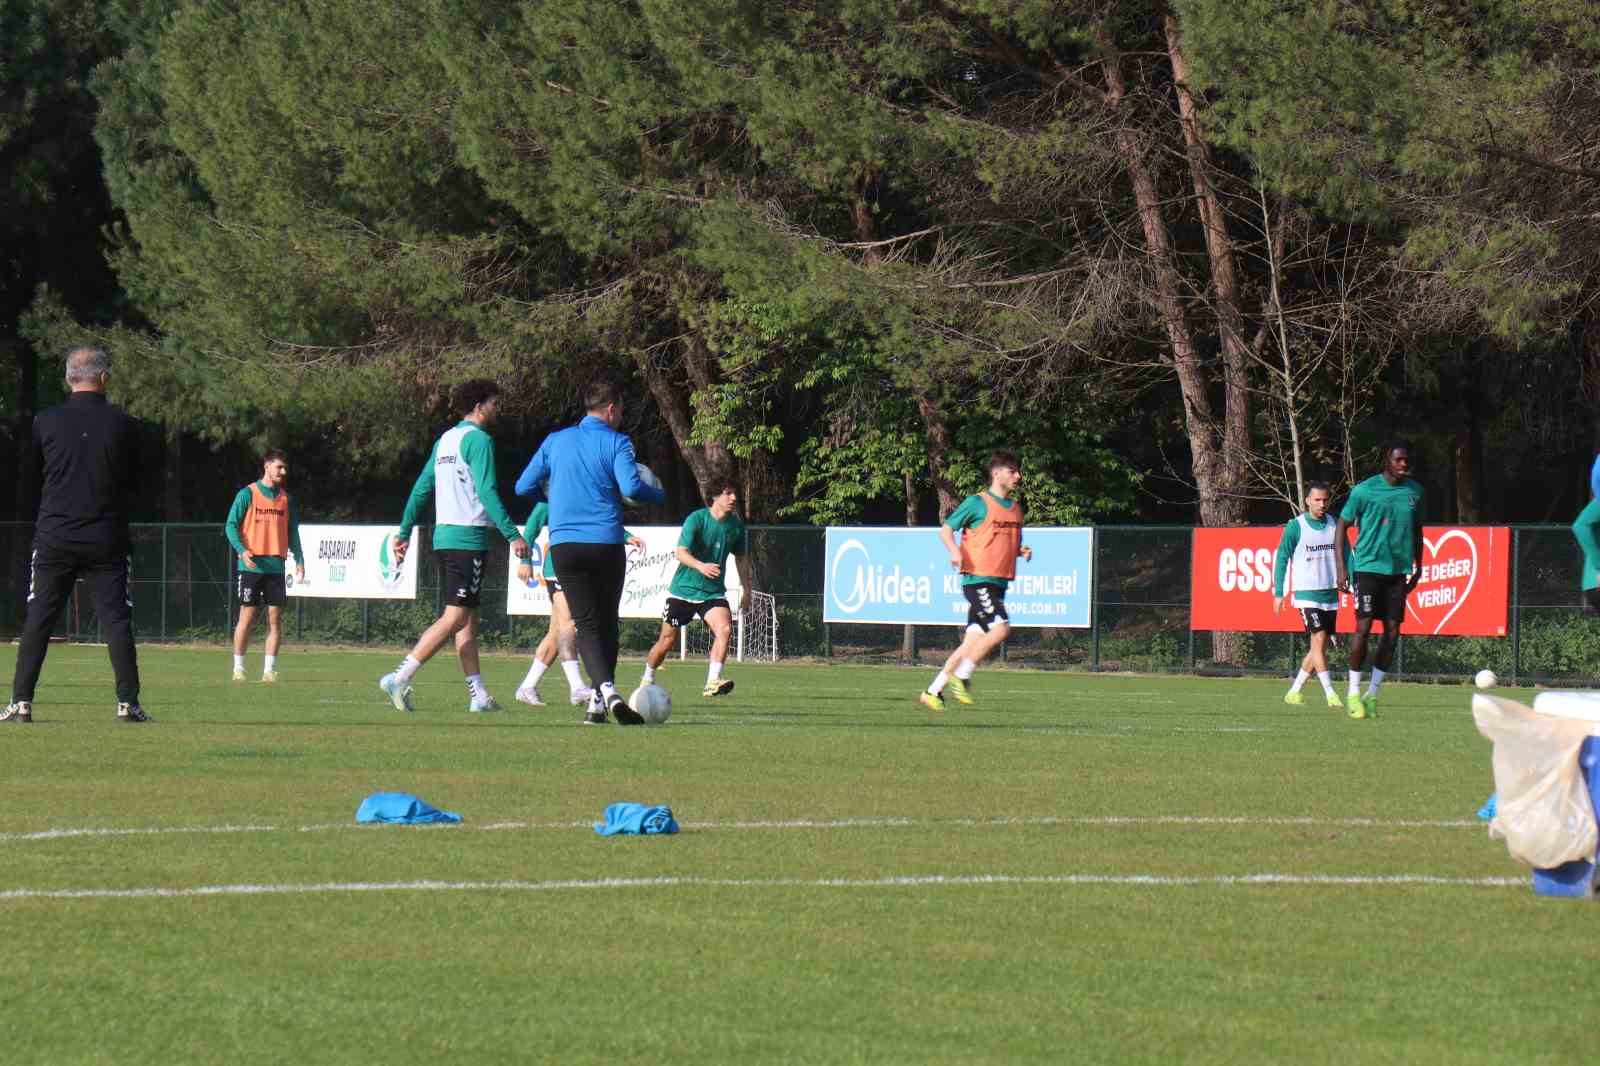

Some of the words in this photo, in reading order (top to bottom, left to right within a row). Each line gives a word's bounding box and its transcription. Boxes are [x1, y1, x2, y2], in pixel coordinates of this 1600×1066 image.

[1305, 543, 1336, 554] humme
[831, 538, 932, 614] Midea
[1005, 569, 1078, 596] STEMLERİ
[1218, 547, 1290, 598] ess
[1431, 558, 1471, 582] DEĞER
[1417, 584, 1457, 609] VERİR!
